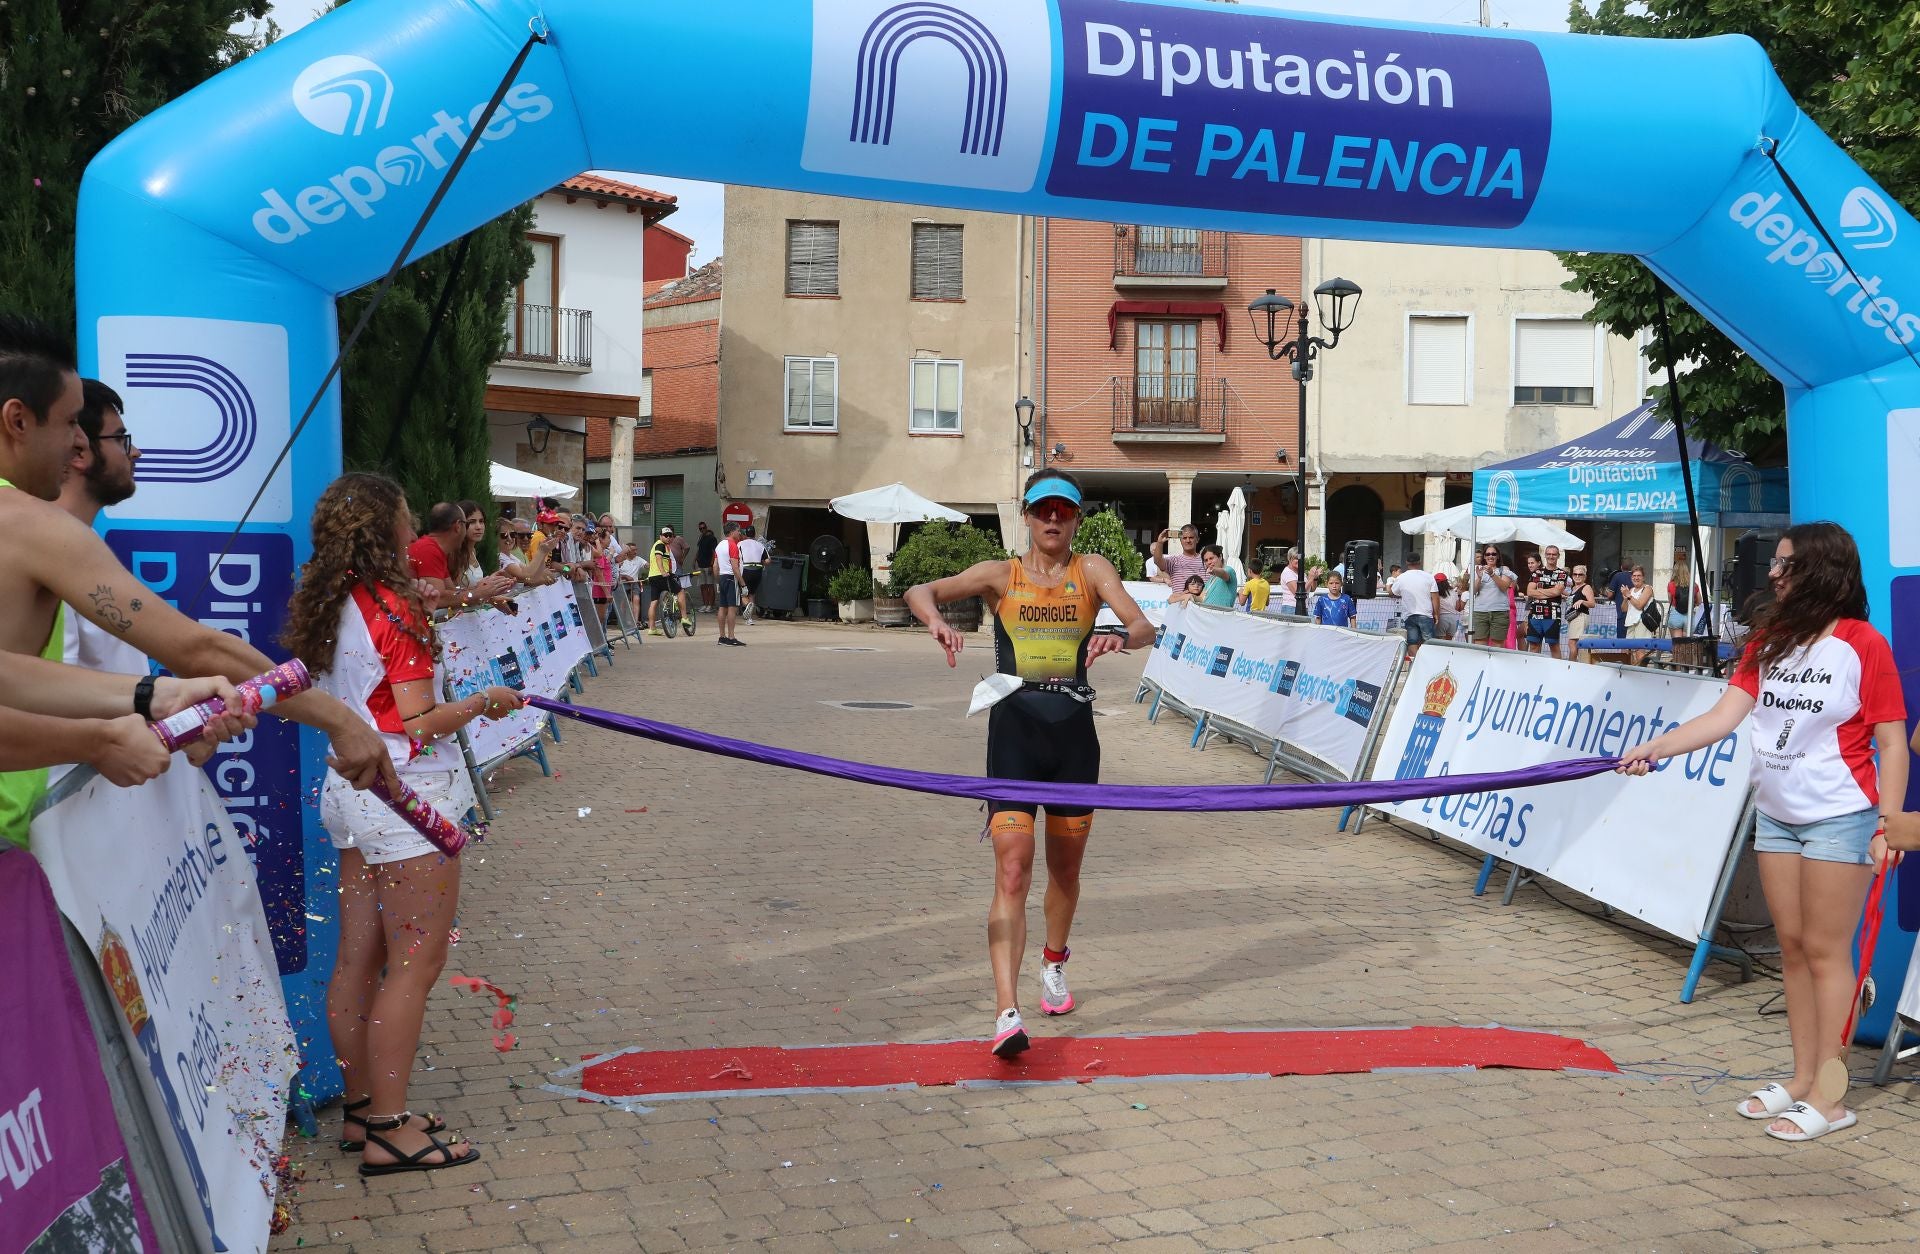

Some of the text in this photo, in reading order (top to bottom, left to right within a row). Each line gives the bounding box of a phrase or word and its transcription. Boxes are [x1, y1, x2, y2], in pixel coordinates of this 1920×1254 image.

[1085, 22, 1454, 109] Diputación
[252, 83, 554, 244] deportes
[1077, 112, 1525, 199] DE PALENCIA
[1729, 191, 1920, 344] deportes
[1559, 446, 1657, 459] Diputación
[1569, 465, 1657, 487] Diputación
[1567, 491, 1677, 512] DE PALENCIA
[1019, 603, 1078, 623] RODRÍGUEZ
[1232, 650, 1274, 682] deportes
[1762, 690, 1824, 714] Dueñas
[1757, 748, 1796, 761] Ayuntamiento
[1765, 761, 1790, 771] Dueñas
[177, 1002, 219, 1133] Dueñas
